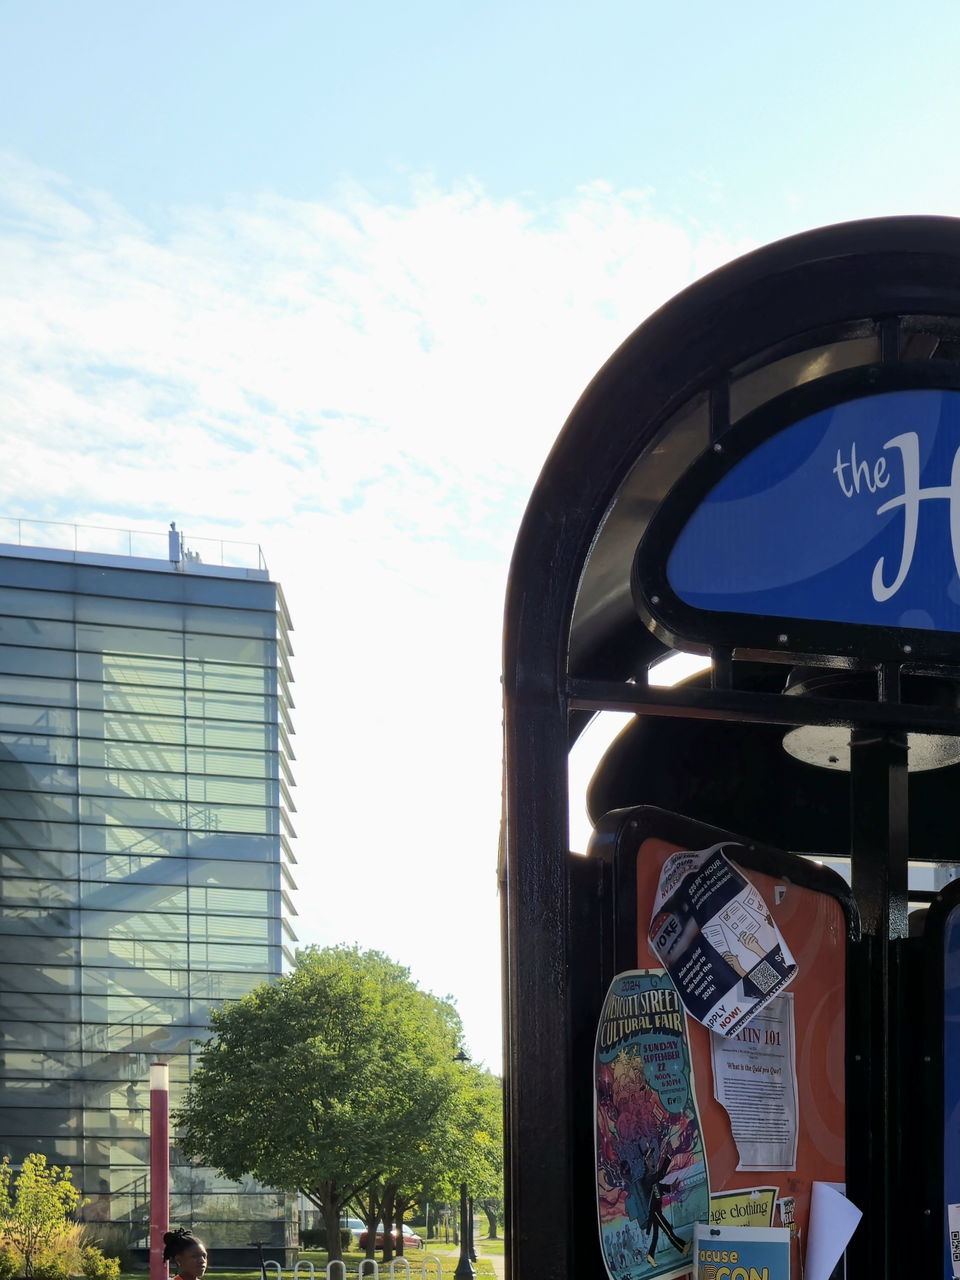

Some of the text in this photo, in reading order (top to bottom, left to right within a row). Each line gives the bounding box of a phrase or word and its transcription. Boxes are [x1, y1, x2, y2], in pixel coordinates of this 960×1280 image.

[833, 442, 890, 498] the
[641, 990, 679, 1014] STREET
[707, 1004, 726, 1029] APPLY
[719, 1007, 741, 1029] NOW!
[601, 1013, 682, 1048] CULTURAL FAIR
[764, 1031, 781, 1046] 101
[643, 1051, 680, 1063] SEPTEMBER
[644, 1041, 678, 1052] SUNDAY
[730, 1201, 769, 1218] clothing
